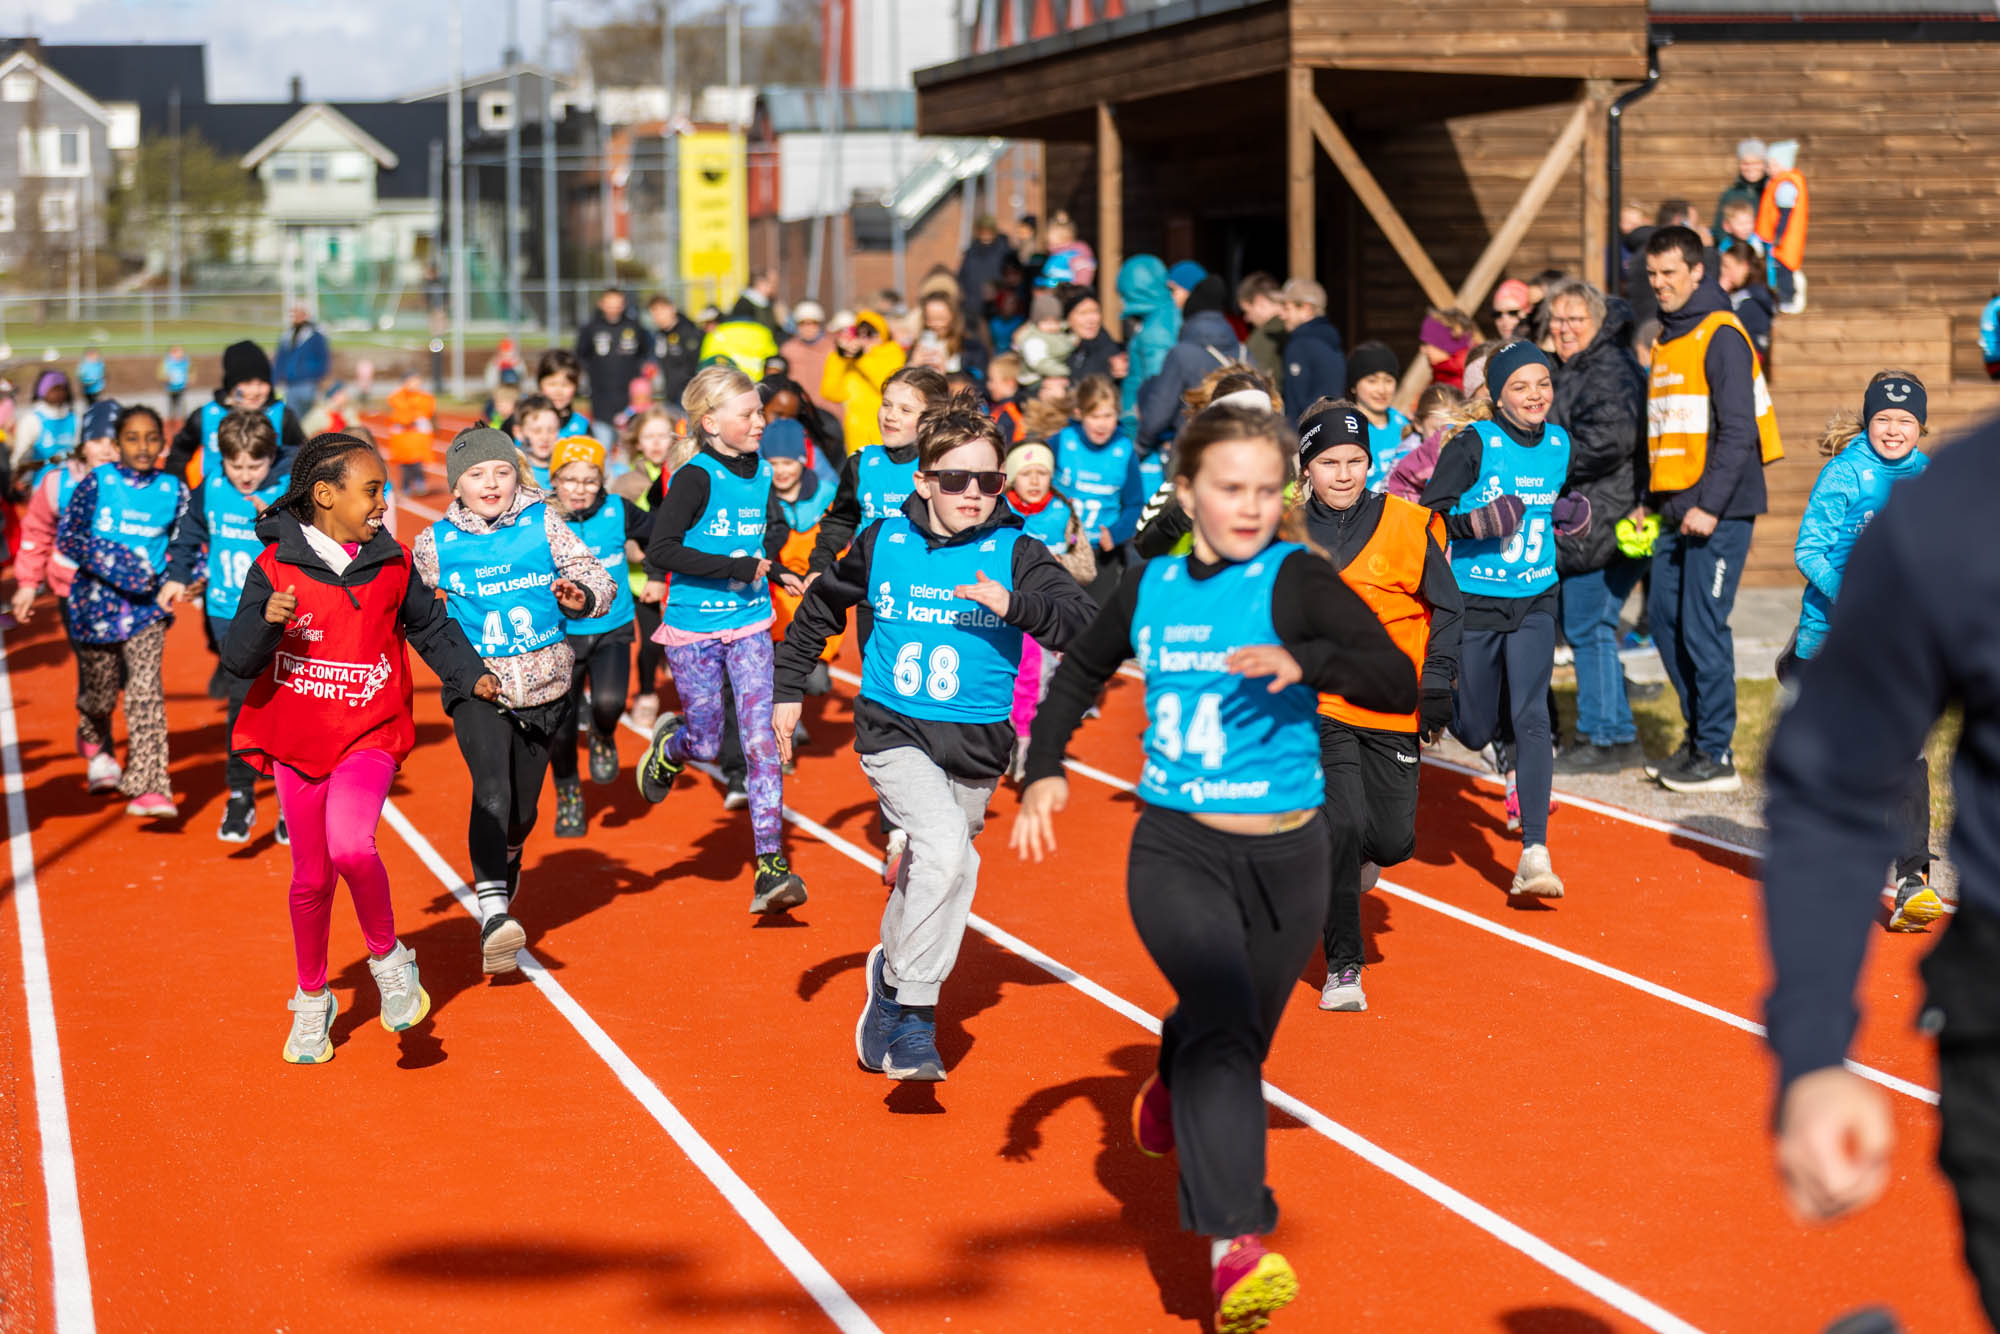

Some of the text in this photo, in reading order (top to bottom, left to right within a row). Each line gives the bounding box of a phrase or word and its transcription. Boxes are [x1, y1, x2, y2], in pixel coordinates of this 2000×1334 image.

[475, 563, 512, 579] telenor
[477, 572, 555, 597] karusellen
[482, 606, 536, 646] 43
[283, 657, 366, 683] NOR-CONTACT
[893, 641, 960, 701] 68
[294, 678, 347, 700] SPORT
[1152, 692, 1228, 770] 34
